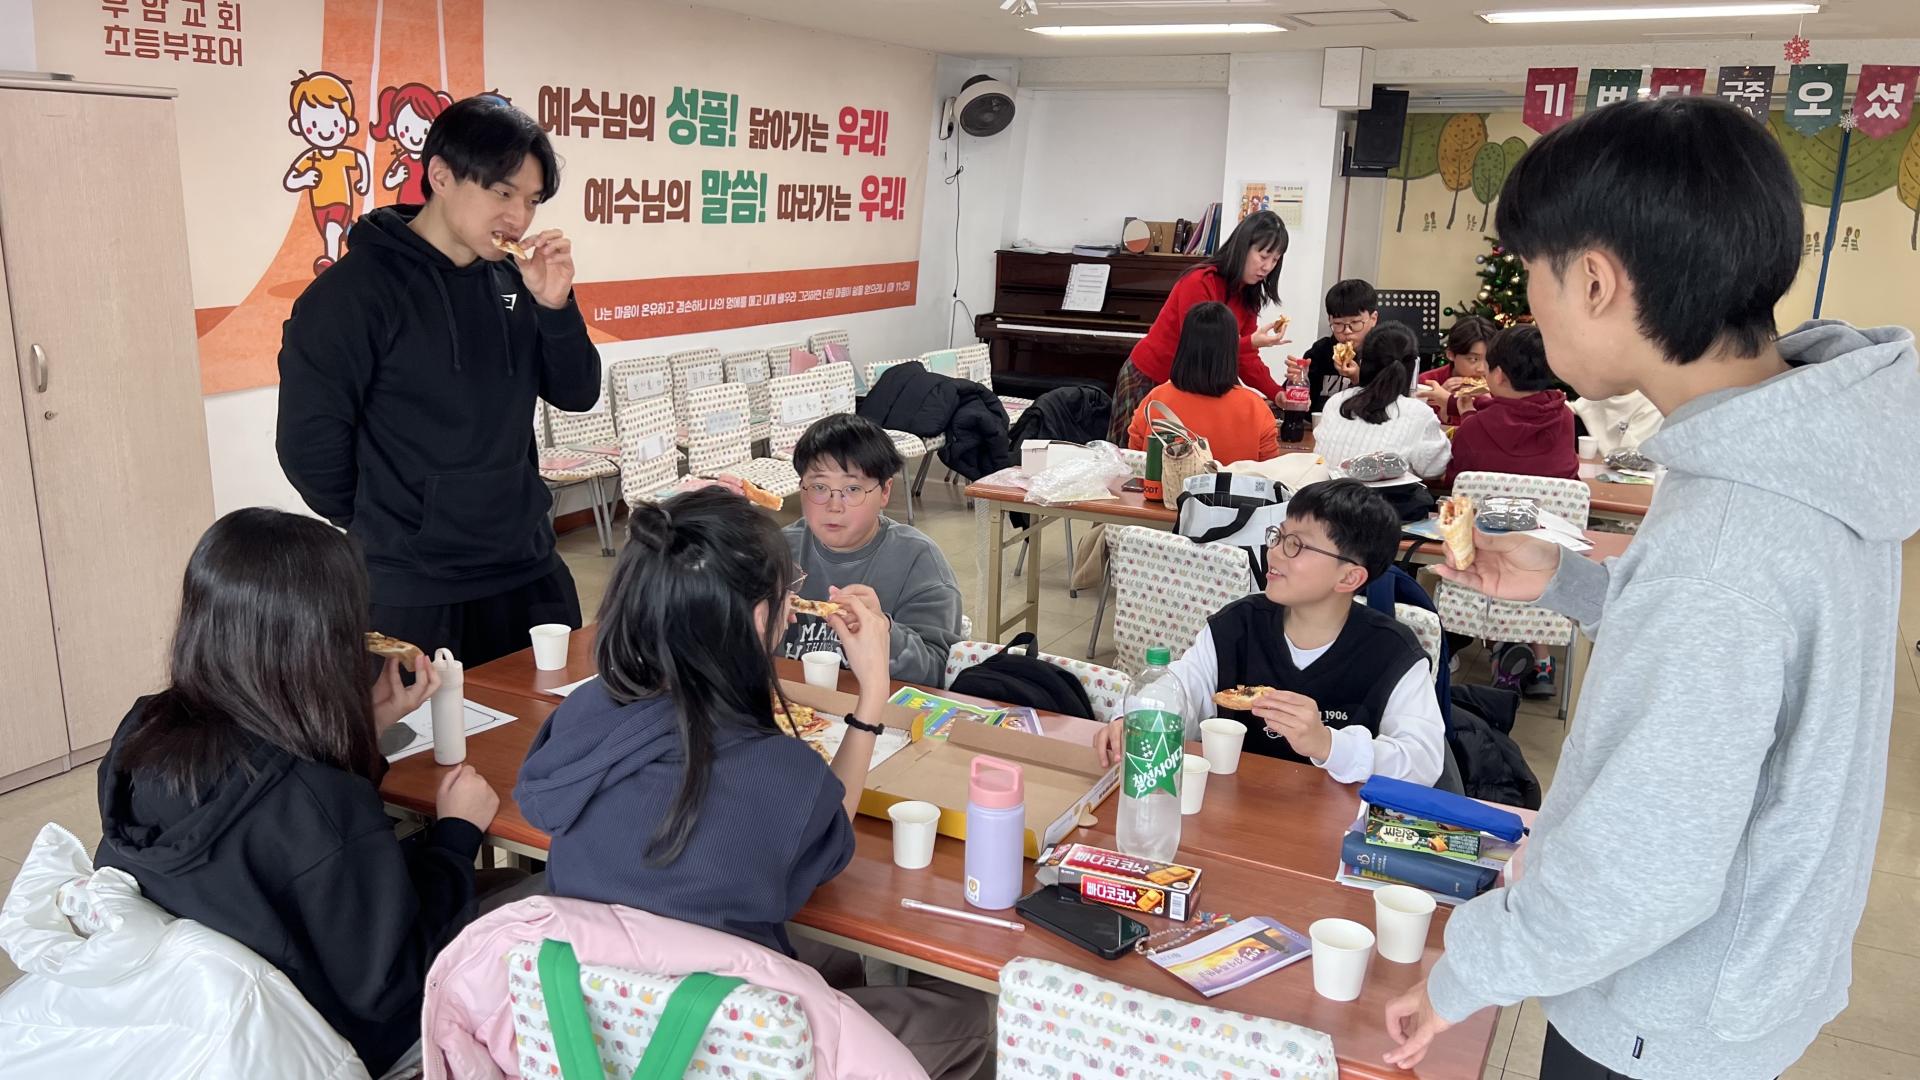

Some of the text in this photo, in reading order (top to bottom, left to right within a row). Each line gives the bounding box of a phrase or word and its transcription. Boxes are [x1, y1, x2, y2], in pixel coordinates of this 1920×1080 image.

[538, 85, 889, 156] 예수님의 성품! 닮아가는 우리!
[584, 170, 907, 224] 예수님의 말씀! 따라가는 우리!
[594, 307, 613, 321] 나는
[614, 305, 640, 319] 마음이
[641, 302, 674, 317] 온유하고
[676, 299, 708, 314] 겸손하니
[709, 298, 725, 310] 나의
[726, 296, 747, 309] 멍에를
[748, 294, 762, 307] 메고
[763, 293, 777, 305] 내게
[777, 292, 797, 304] 배우라
[798, 289, 823, 302] 그리하면
[1324, 710, 1348, 721] 1906
[1075, 851, 1150, 875] 빠다코코낫
[1086, 881, 1137, 905] 빠다코코낫
